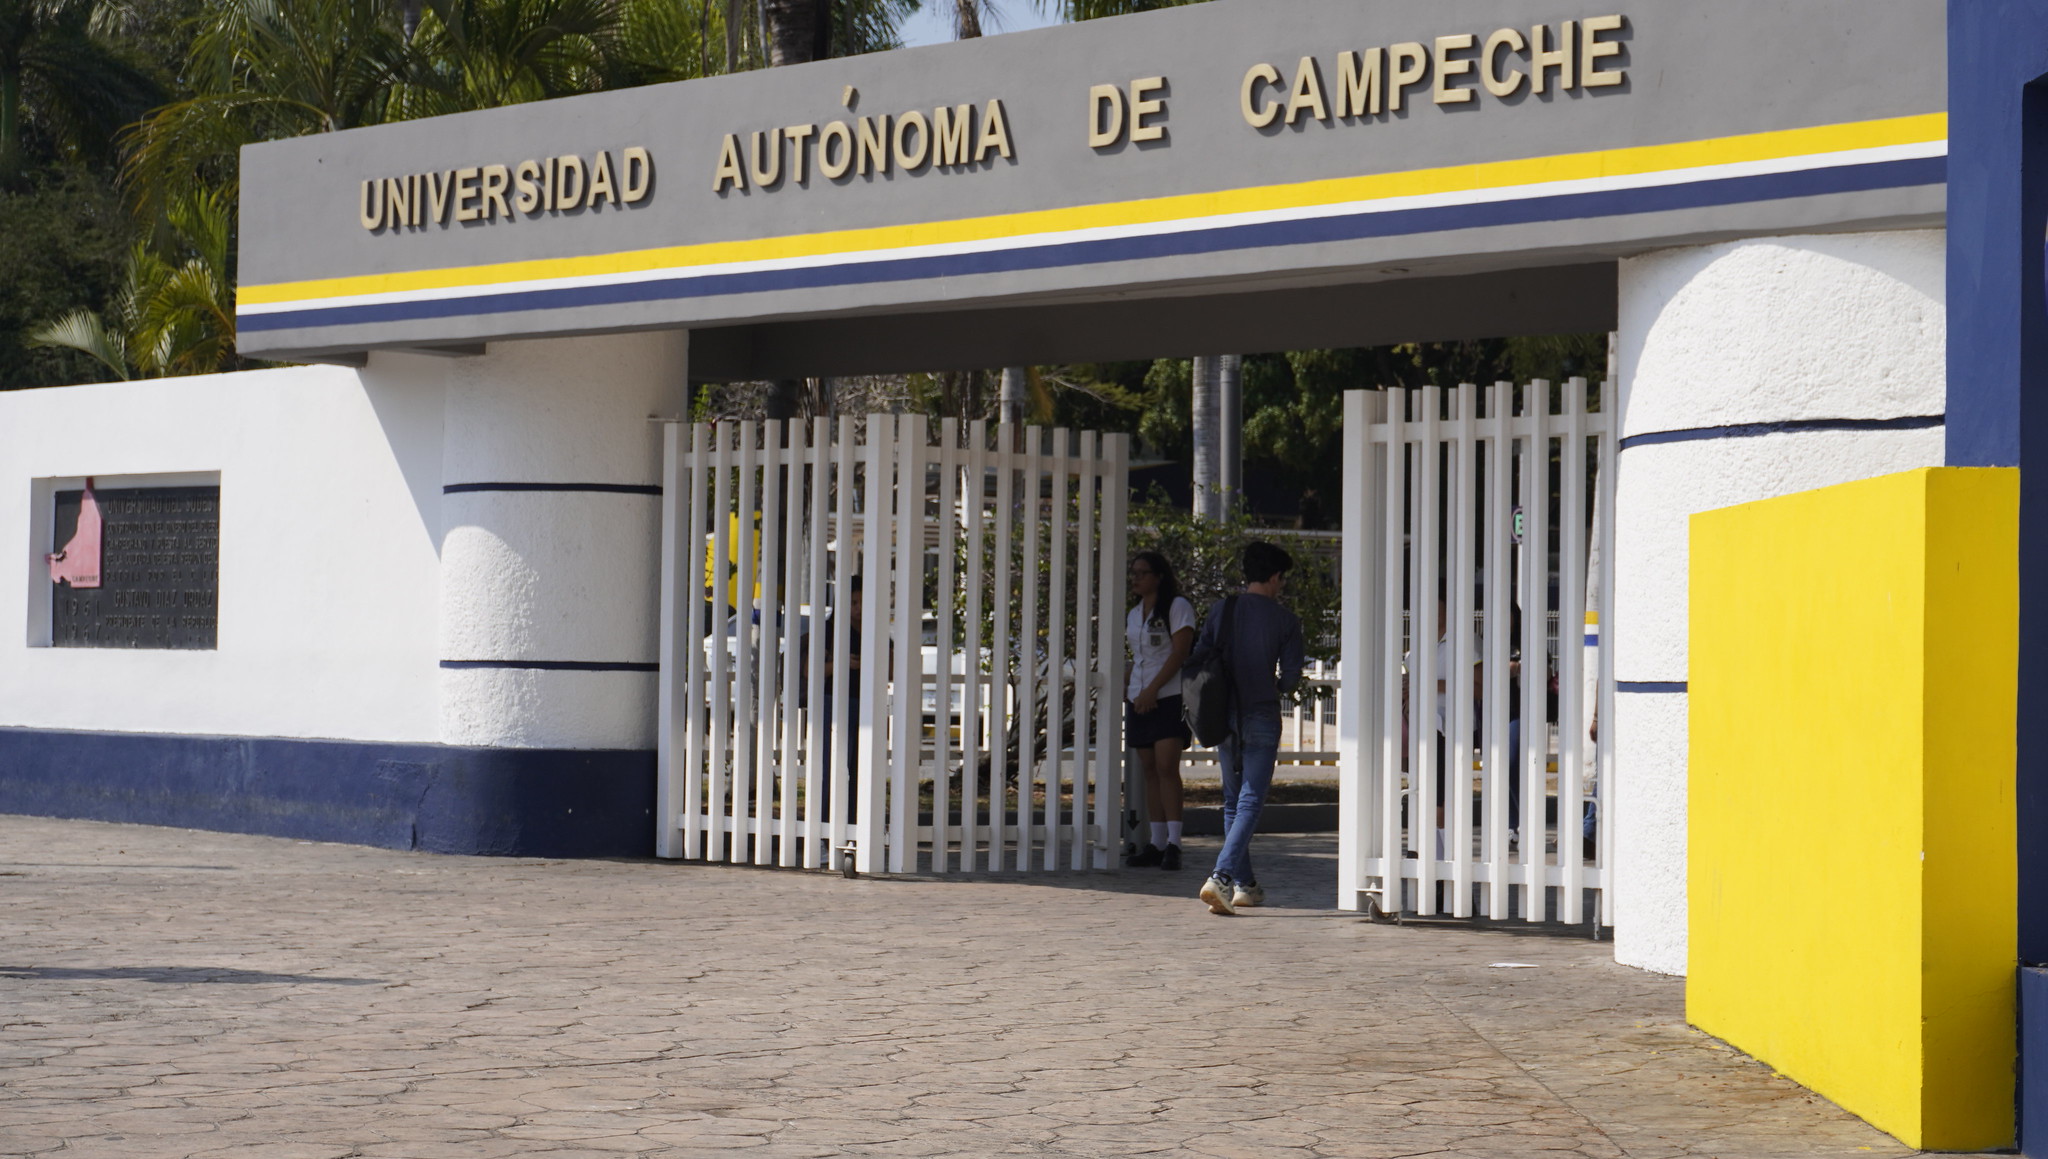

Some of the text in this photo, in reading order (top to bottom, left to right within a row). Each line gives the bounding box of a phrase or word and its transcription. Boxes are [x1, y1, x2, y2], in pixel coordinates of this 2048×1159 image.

[360, 14, 1624, 231] UNIVERSIDAD AUTÓNOMA DE CAMPECHE
[107, 496, 163, 514] UNIVERSIDAD
[166, 496, 182, 514] DEL
[115, 589, 213, 608] GUSTAVO DIAZ ORDAZ
